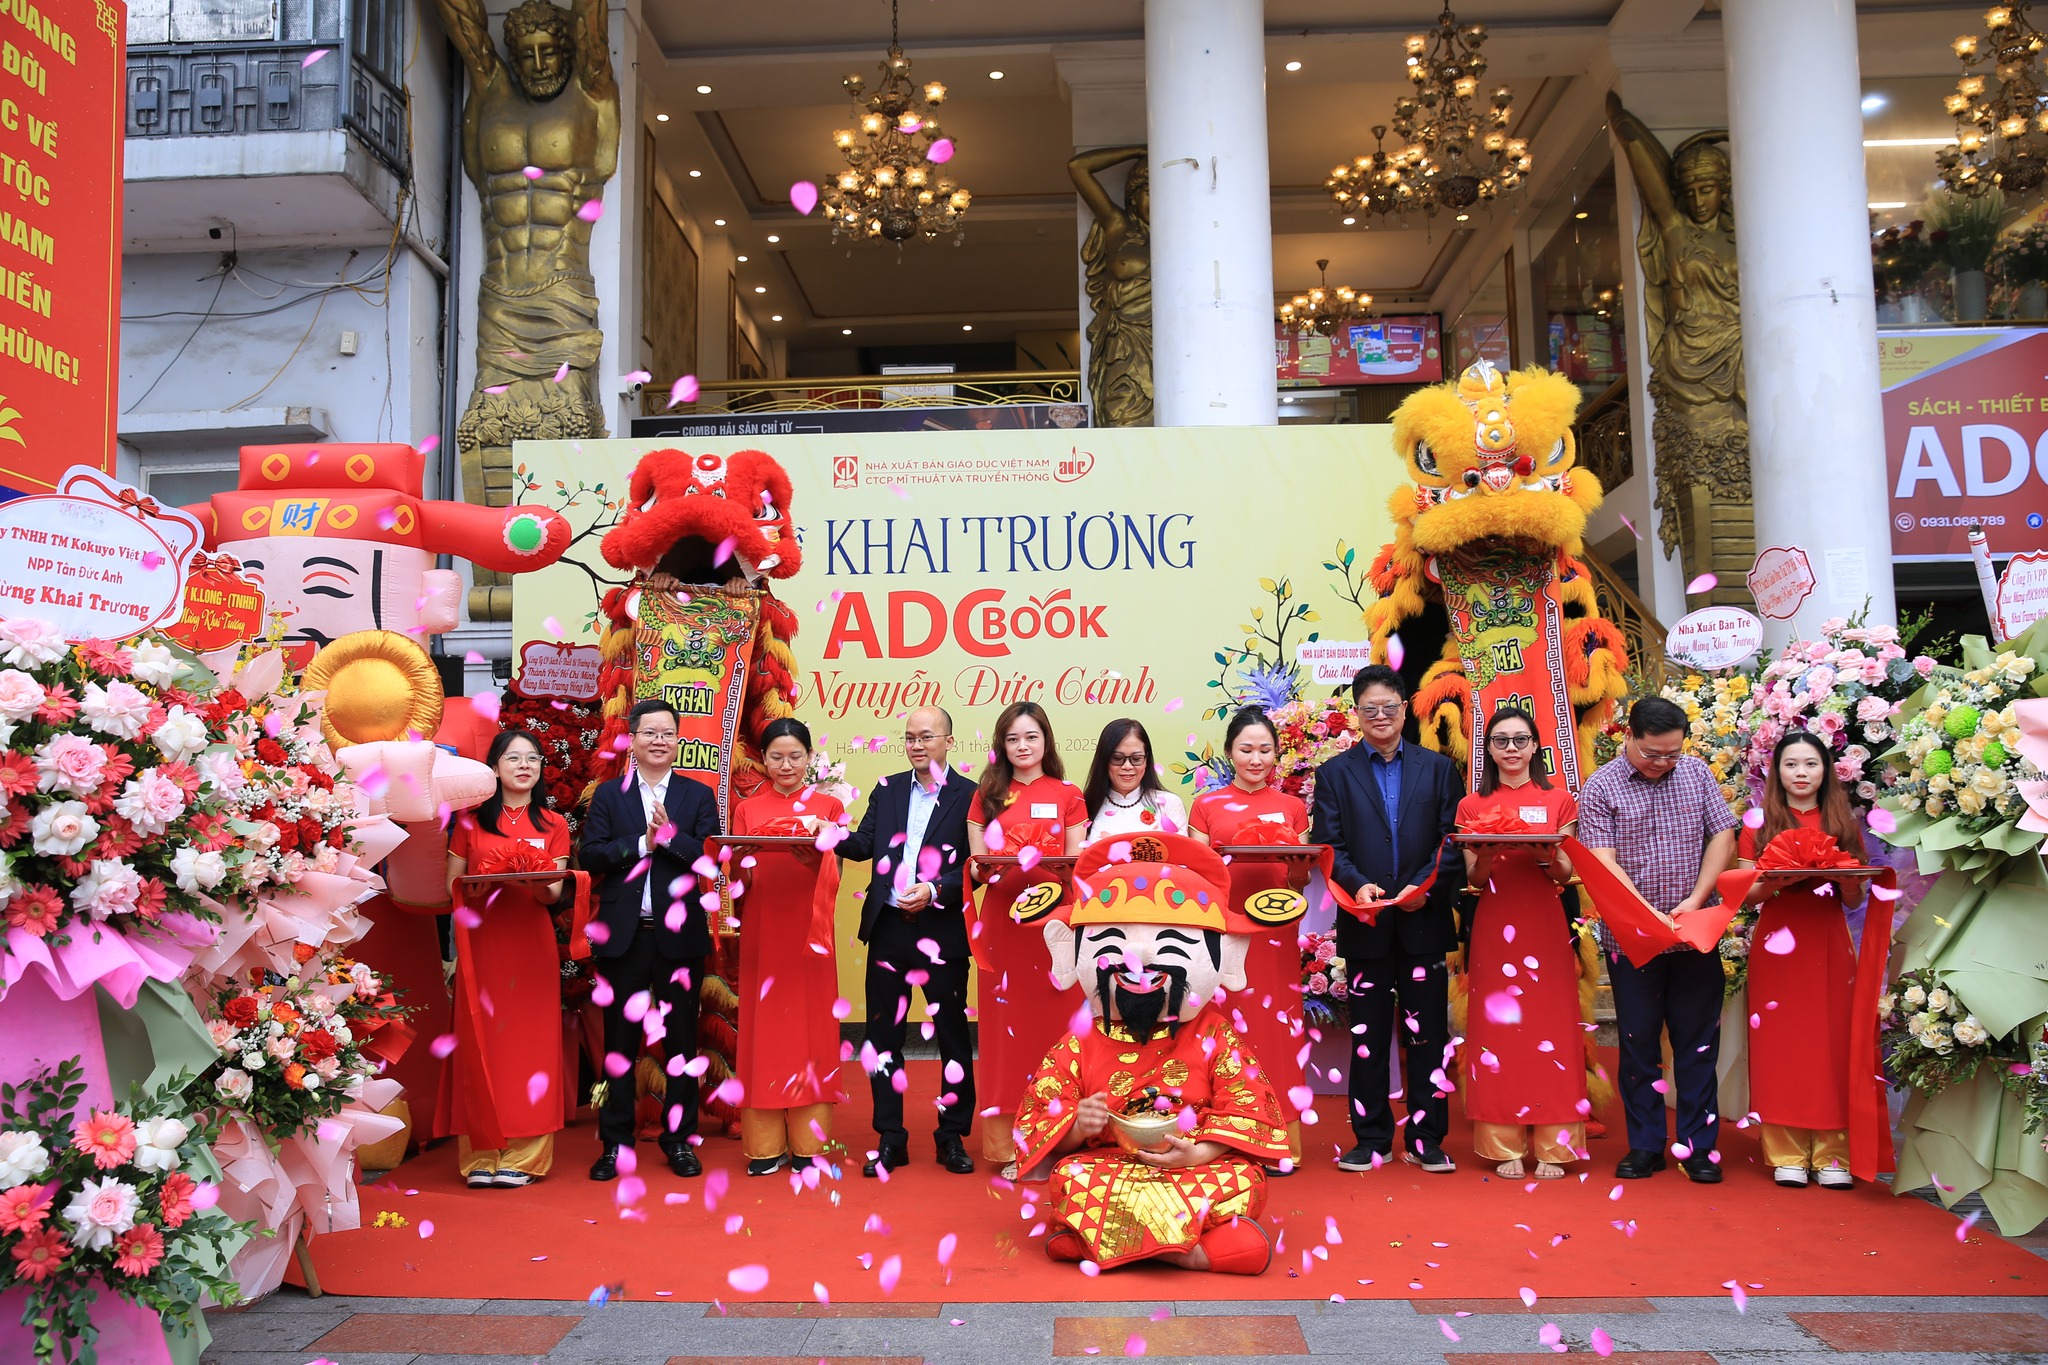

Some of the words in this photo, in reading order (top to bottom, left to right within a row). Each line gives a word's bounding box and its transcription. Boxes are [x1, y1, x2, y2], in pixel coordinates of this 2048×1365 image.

[3, 40, 46, 96] ĐỜI
[27, 113, 58, 159] VỀ
[0, 152, 50, 207] TỘC
[0, 210, 54, 265] NAM
[0, 324, 79, 386] HÙNG!
[1908, 398, 1961, 416] SÁCH
[1978, 393, 2035, 414] THIẾT
[682, 425, 717, 437] COMBO
[719, 422, 735, 435] HẢI
[738, 421, 758, 434] SẢN
[761, 420, 777, 434] CHỈ
[780, 421, 793, 433] TỪ
[865, 461, 888, 470] NHÀ
[891, 460, 919, 470] XUẤT
[922, 459, 944, 469] BẢN
[947, 458, 973, 469] GIÁO
[976, 460, 997, 470] DỤC
[1000, 458, 1023, 469] VIỆT
[1895, 424, 2048, 498] AD
[865, 476, 893, 484] CTCP
[896, 475, 908, 484] MĨ
[911, 474, 946, 485] THUẬT
[949, 473, 963, 483] VÀ
[966, 471, 1009, 483] TRUYỀN
[1012, 473, 1050, 482] THÔNG
[280, 502, 320, 531] 财
[1920, 516, 2006, 528] 0931.068.789
[12, 527, 48, 545] TNHH
[51, 534, 69, 548] TM
[71, 538, 115, 557] Kokuyo
[118, 546, 140, 563] Việt
[824, 517, 951, 575] KHAI
[961, 510, 1197, 573] TRƯƠNG
[28, 557, 54, 572] NPP
[57, 561, 76, 577] Tân
[78, 566, 100, 581] Đức
[102, 570, 123, 585] Anh
[40, 586, 84, 608] Khai
[89, 594, 150, 621] Trương
[227, 593, 258, 612] (TNHH)
[201, 609, 222, 631] Khai
[221, 611, 246, 638] Trương
[1678, 623, 1695, 635] Nhà
[1697, 621, 1717, 633] Xuất
[1719, 619, 1735, 631] Bản
[1303, 647, 1313, 659] NHÀ
[1314, 646, 1325, 659] XUẤT
[1326, 646, 1337, 659] BẢN
[1337, 647, 1348, 659] GIÁO
[1349, 648, 1359, 660] DỤC
[1359, 647, 1369, 660] VIỆT
[1493, 639, 1523, 671] MÃ
[1712, 637, 1729, 651] Khai
[527, 667, 546, 677] Thành
[569, 669, 580, 679] Chí
[581, 671, 596, 680] Minh
[1319, 664, 1339, 679] Chúc
[664, 685, 714, 715] KHAI
[794, 668, 944, 720] Nguyễn
[955, 665, 1045, 707] Đức
[1055, 666, 1158, 708] Cảnh
[1065, 739, 1097, 752] 2025
